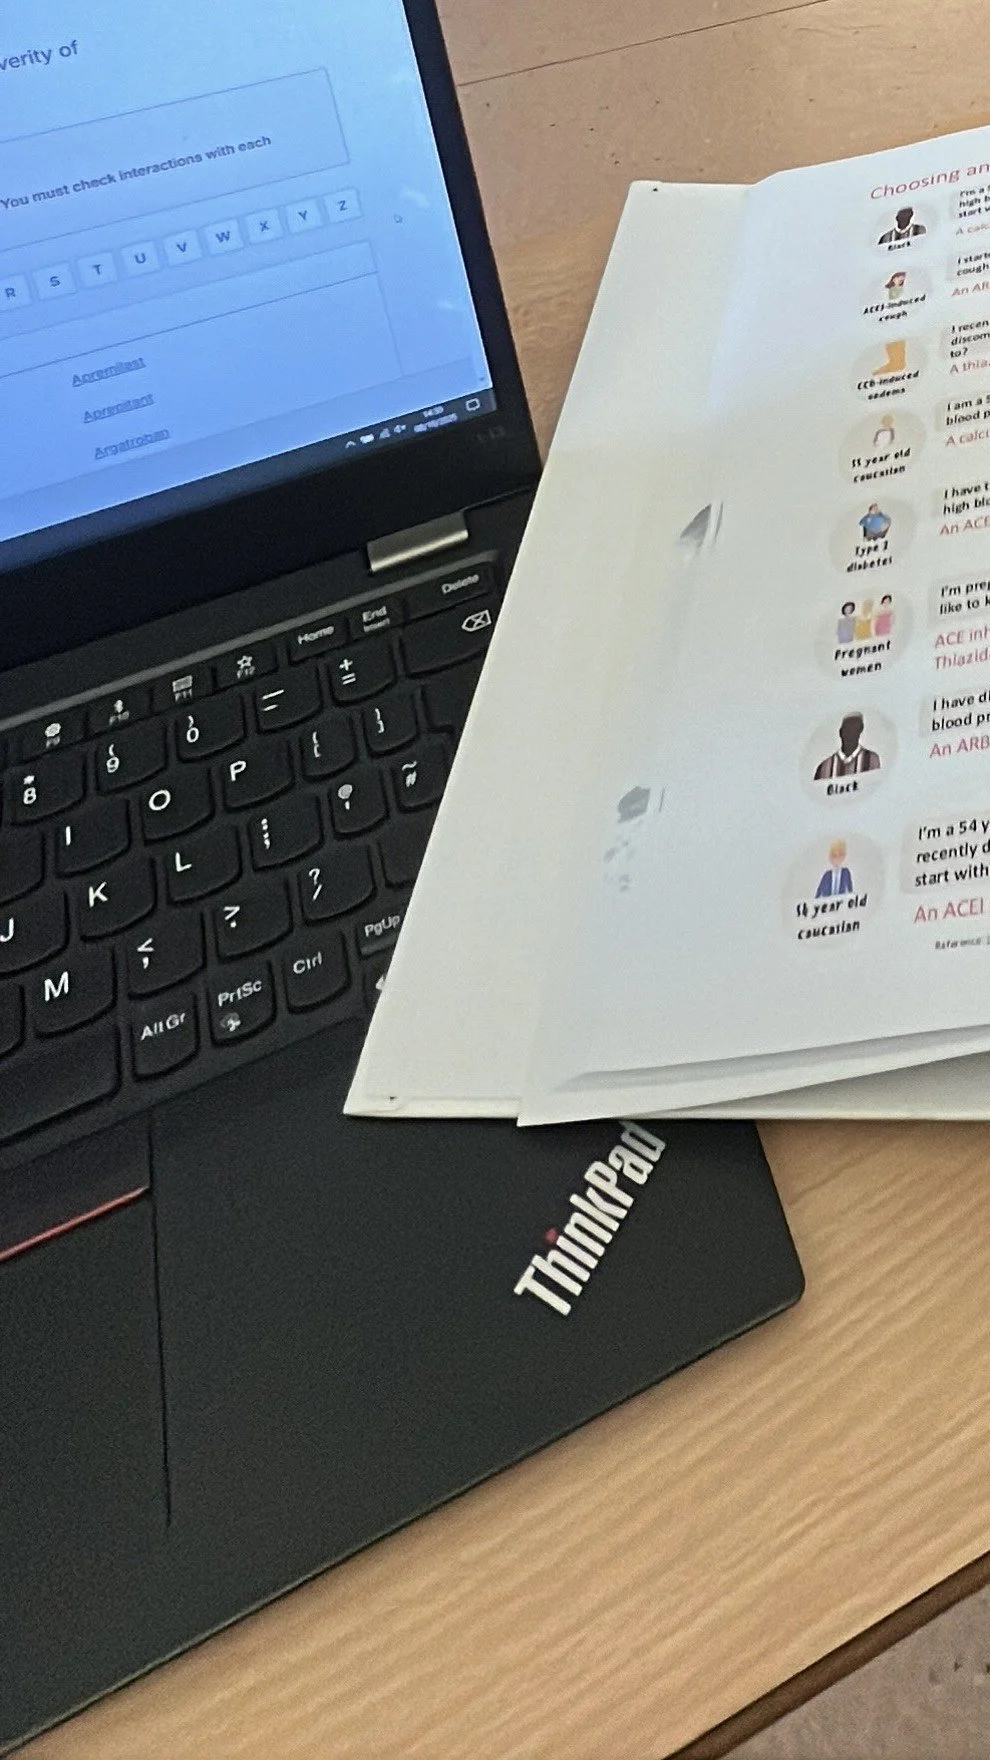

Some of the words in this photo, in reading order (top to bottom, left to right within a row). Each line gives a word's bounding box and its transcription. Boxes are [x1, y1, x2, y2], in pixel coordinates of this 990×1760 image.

[59, 40, 79, 58] of
[2, 194, 29, 210] You
[33, 187, 69, 202] must
[73, 173, 116, 193] check
[118, 151, 203, 182] interactions
[205, 144, 235, 160] with
[238, 136, 272, 152] each
[870, 169, 961, 200] Choosing
[967, 162, 990, 177] an
[6, 287, 16, 298] R
[49, 275, 61, 287] S
[92, 264, 102, 276] T
[135, 252, 147, 264] U
[176, 241, 187, 253] V
[216, 230, 231, 243] W
[259, 220, 270, 232] X
[298, 209, 309, 220] Y
[339, 200, 348, 211] Z
[940, 585, 961, 597] I'm
[362, 606, 387, 622] End
[940, 603, 963, 615] like
[967, 597, 980, 609] to
[298, 626, 335, 644] Home
[934, 633, 964, 648] ACE
[834, 640, 891, 661] Pregnant
[841, 662, 882, 677] women
[941, 695, 975, 709] have
[932, 713, 972, 731] blood
[930, 742, 951, 758] An
[956, 735, 990, 754] ARB
[229, 760, 246, 781] P
[23, 787, 37, 804] 8
[918, 826, 941, 840] I'm
[946, 826, 955, 836] a
[959, 820, 978, 834] 54
[175, 852, 192, 872] L
[917, 842, 978, 864] recently
[915, 870, 949, 887] start
[88, 881, 108, 907] K
[914, 906, 938, 924] An
[942, 898, 984, 920] ACEI
[365, 915, 400, 937] PgUp
[293, 951, 322, 974] Ctrl
[44, 971, 69, 1001] M
[218, 980, 262, 1006] PrtSc
[513, 1118, 667, 1316] ThinkPad
